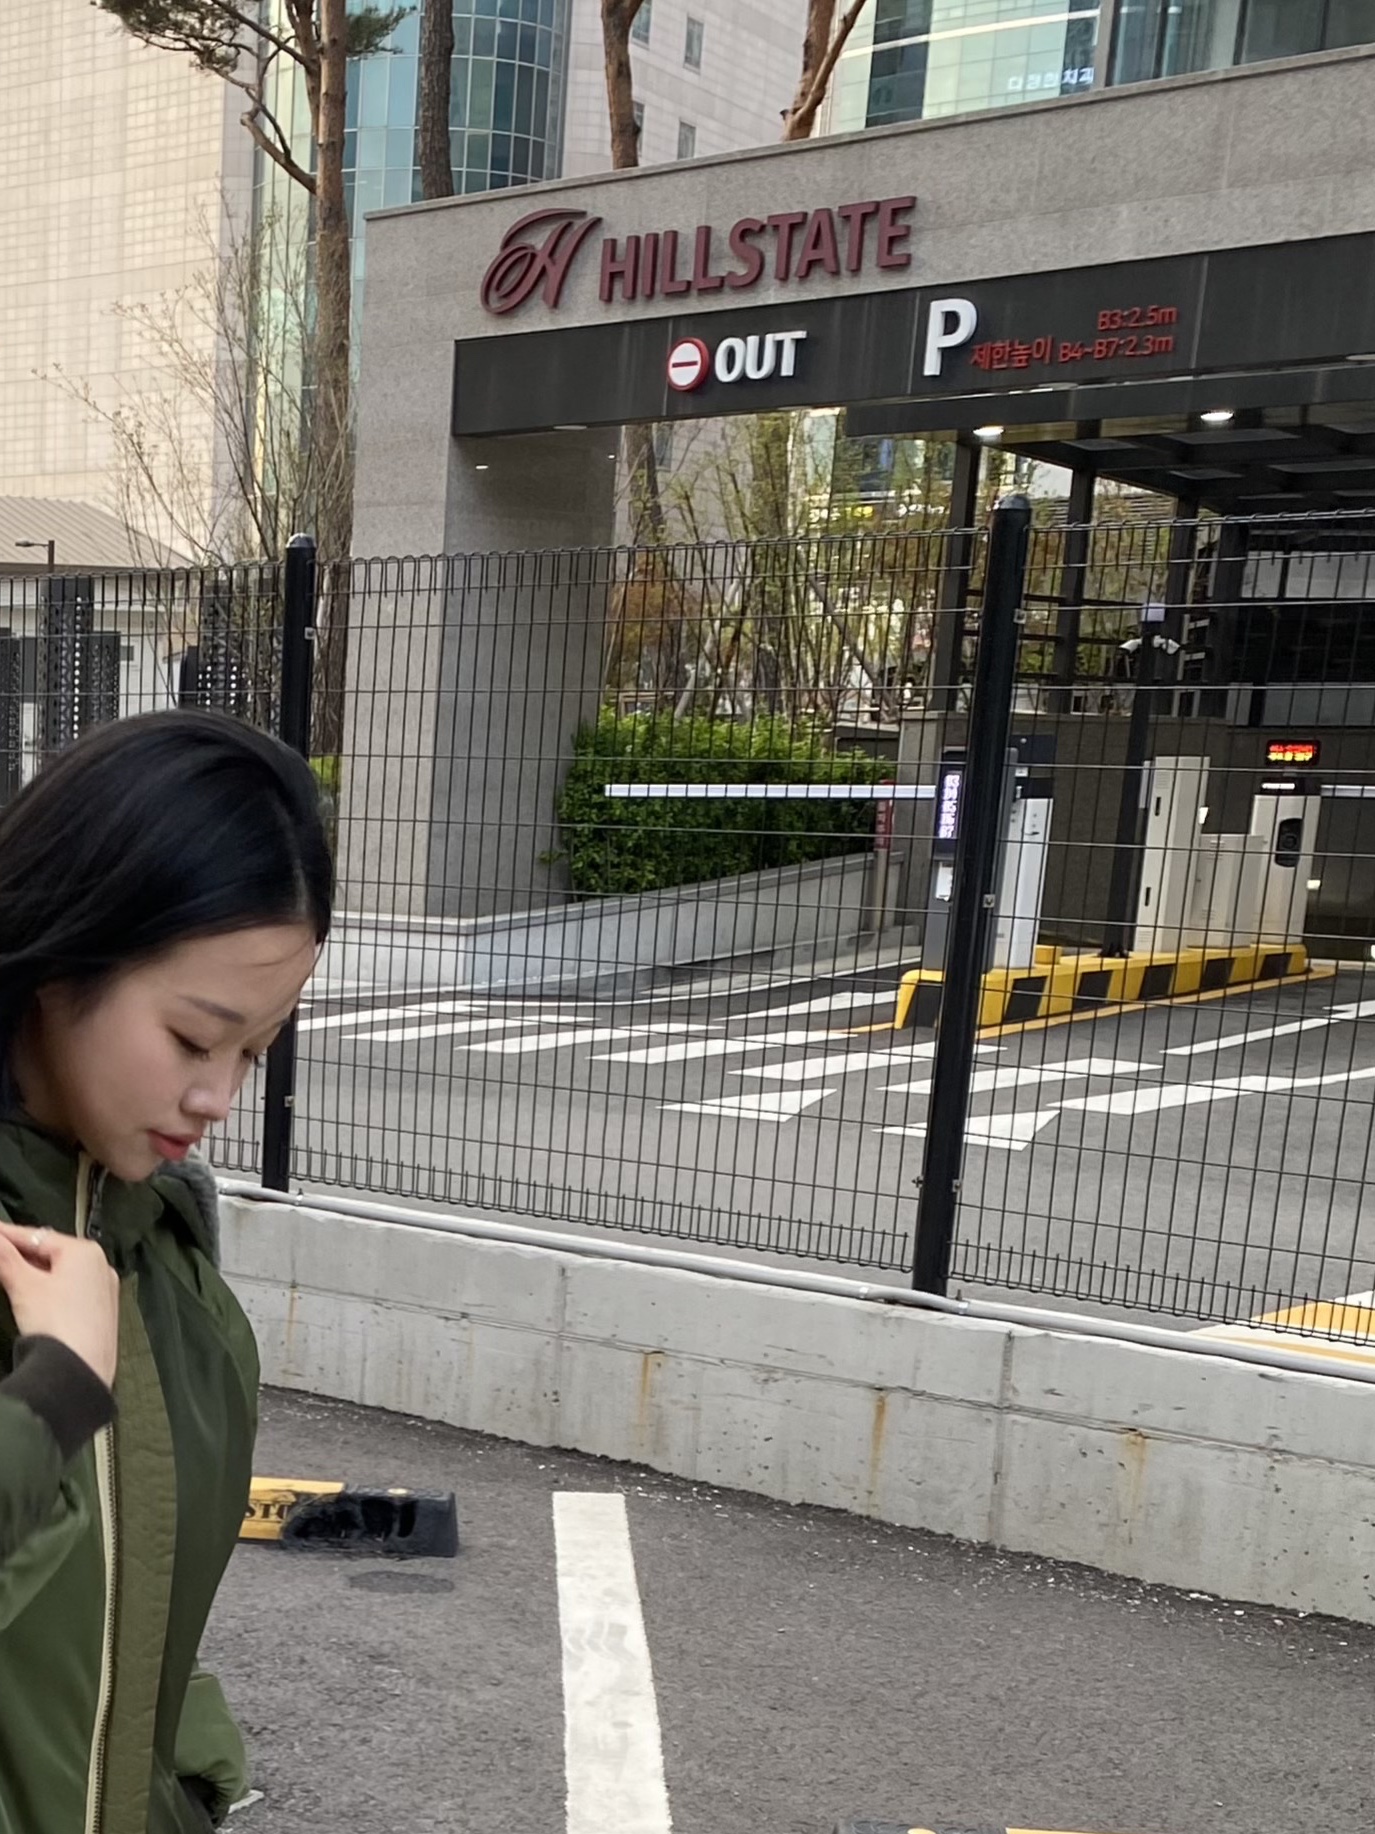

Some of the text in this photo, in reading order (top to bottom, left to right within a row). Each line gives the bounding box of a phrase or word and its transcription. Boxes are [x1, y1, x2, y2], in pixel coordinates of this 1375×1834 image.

[599, 195, 917, 303] HILLSTATE
[923, 298, 977, 376] P
[1097, 305, 1178, 330] B3:2.5m
[714, 330, 808, 383] OUT
[969, 336, 1054, 370] 제한높이
